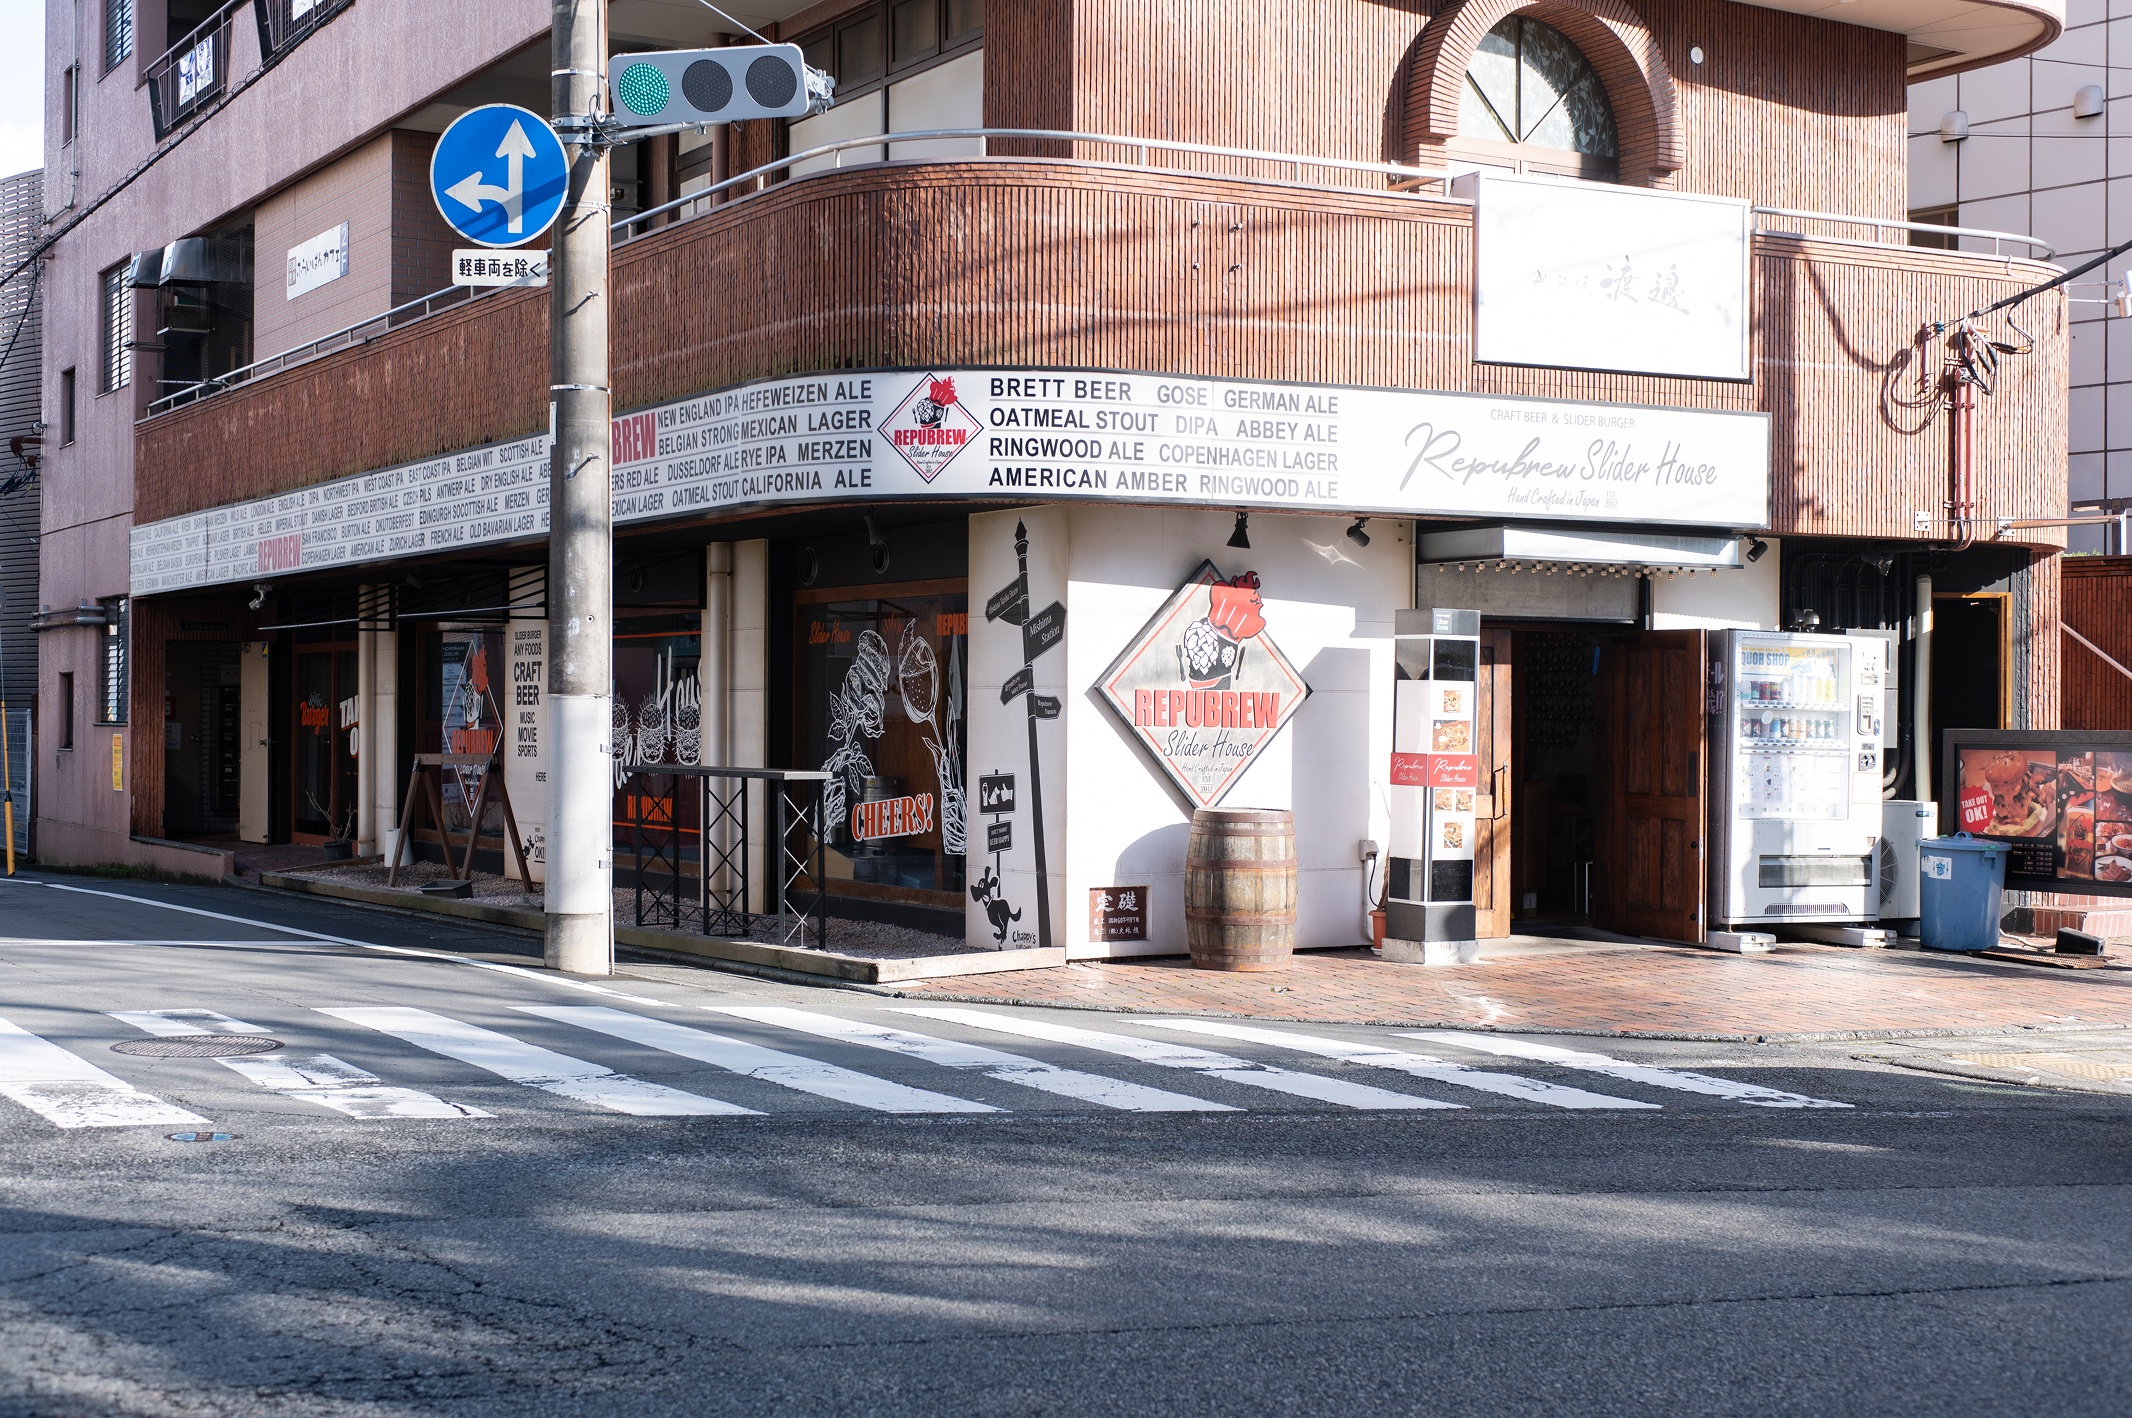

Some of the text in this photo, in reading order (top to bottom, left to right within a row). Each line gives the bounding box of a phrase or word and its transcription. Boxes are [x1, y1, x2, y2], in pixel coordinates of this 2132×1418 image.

[459, 258, 541, 277] 軽車両を除く
[658, 380, 871, 429] NEW ENGLAND IPA HEFEWEIZEN ALE
[990, 378, 1338, 414] BRETT BEER GOSE GERMAN ALE
[990, 408, 1337, 442] OATMEAL STOUT DIPA ABBEY ALE
[1489, 409, 1634, 428] CRAFT BEER & SLIDER BURGER
[659, 410, 871, 456] BELGIAN STRONG MEXICAN LAGER
[894, 429, 966, 445] REPUBREW
[627, 470, 642, 488] RED
[644, 467, 658, 485] ALE
[668, 455, 721, 481] DUSSELDORF
[724, 451, 739, 471] ALE
[742, 448, 762, 468] RYE
[766, 445, 786, 464] IPA
[798, 439, 871, 461] MERZEN
[908, 445, 953, 458] Slider House
[990, 438, 1338, 471] RINGWOOD ALE COPENHAGEN LAGER
[1398, 422, 1716, 491] Repubrew Slider House
[364, 439, 542, 492] WEST COAST IPA COAST IPA BELGIAN WIT SCOTTISH ALE
[329, 466, 533, 520] LAGER BEDFORD BRITISH ALE CZECH PILS ANTWERP ALE DRY ENGLISH ALE
[639, 492, 663, 512] LAGER
[673, 485, 710, 507] OATMEAL
[712, 480, 739, 501] STOUT
[742, 471, 822, 496] CALIFORNIA
[835, 468, 871, 488] ALE
[989, 467, 1337, 499] AMERICAN AMBER RINGWOOD ALE
[1507, 486, 1599, 512] Hand Crafted in Japan
[258, 534, 301, 572] REPUBREW
[302, 532, 311, 545] SAN
[342, 522, 360, 538] BURTON
[361, 521, 370, 535] ALE
[453, 500, 485, 520] SOCOTTISH
[486, 497, 498, 513] ALE
[505, 491, 530, 510] MERZEN
[302, 548, 330, 564] COPENHAGEN
[331, 546, 346, 560] LAGER
[350, 541, 375, 557] AMERICAN
[375, 540, 384, 553] ALE
[390, 536, 407, 551] ZURICH
[408, 533, 425, 549] LAGER
[431, 528, 452, 545] FRENCH
[453, 526, 464, 541] ALE
[470, 522, 482, 539] OLD
[483, 518, 513, 537] BAVARIAN
[514, 514, 534, 532] LAGER
[809, 619, 851, 645] Slider House
[1030, 615, 1051, 637] Mishima
[1042, 626, 1059, 644] Station
[514, 642, 542, 656] ANY FOODS
[1766, 653, 1790, 666] SHOP
[513, 661, 542, 682] CRAFT
[516, 685, 539, 706] BEER
[300, 701, 329, 735] Burger
[520, 712, 536, 724] MUSIC
[1134, 689, 1280, 728] REPUBREW
[452, 730, 493, 753] REPUBREW
[518, 727, 537, 743] MOVIE
[1163, 729, 1254, 759] Slider House
[518, 743, 537, 758] SPORTS
[1181, 762, 1193, 773] Hand
[1195, 762, 1213, 775] Crafted
[1219, 763, 1233, 775] Japan
[1434, 758, 1472, 775] Repubrew
[1961, 795, 1987, 809] TAKE OUT
[1965, 805, 1988, 823] OK!
[852, 793, 933, 842] CHEERS!
[1095, 891, 1138, 912] 定礎
